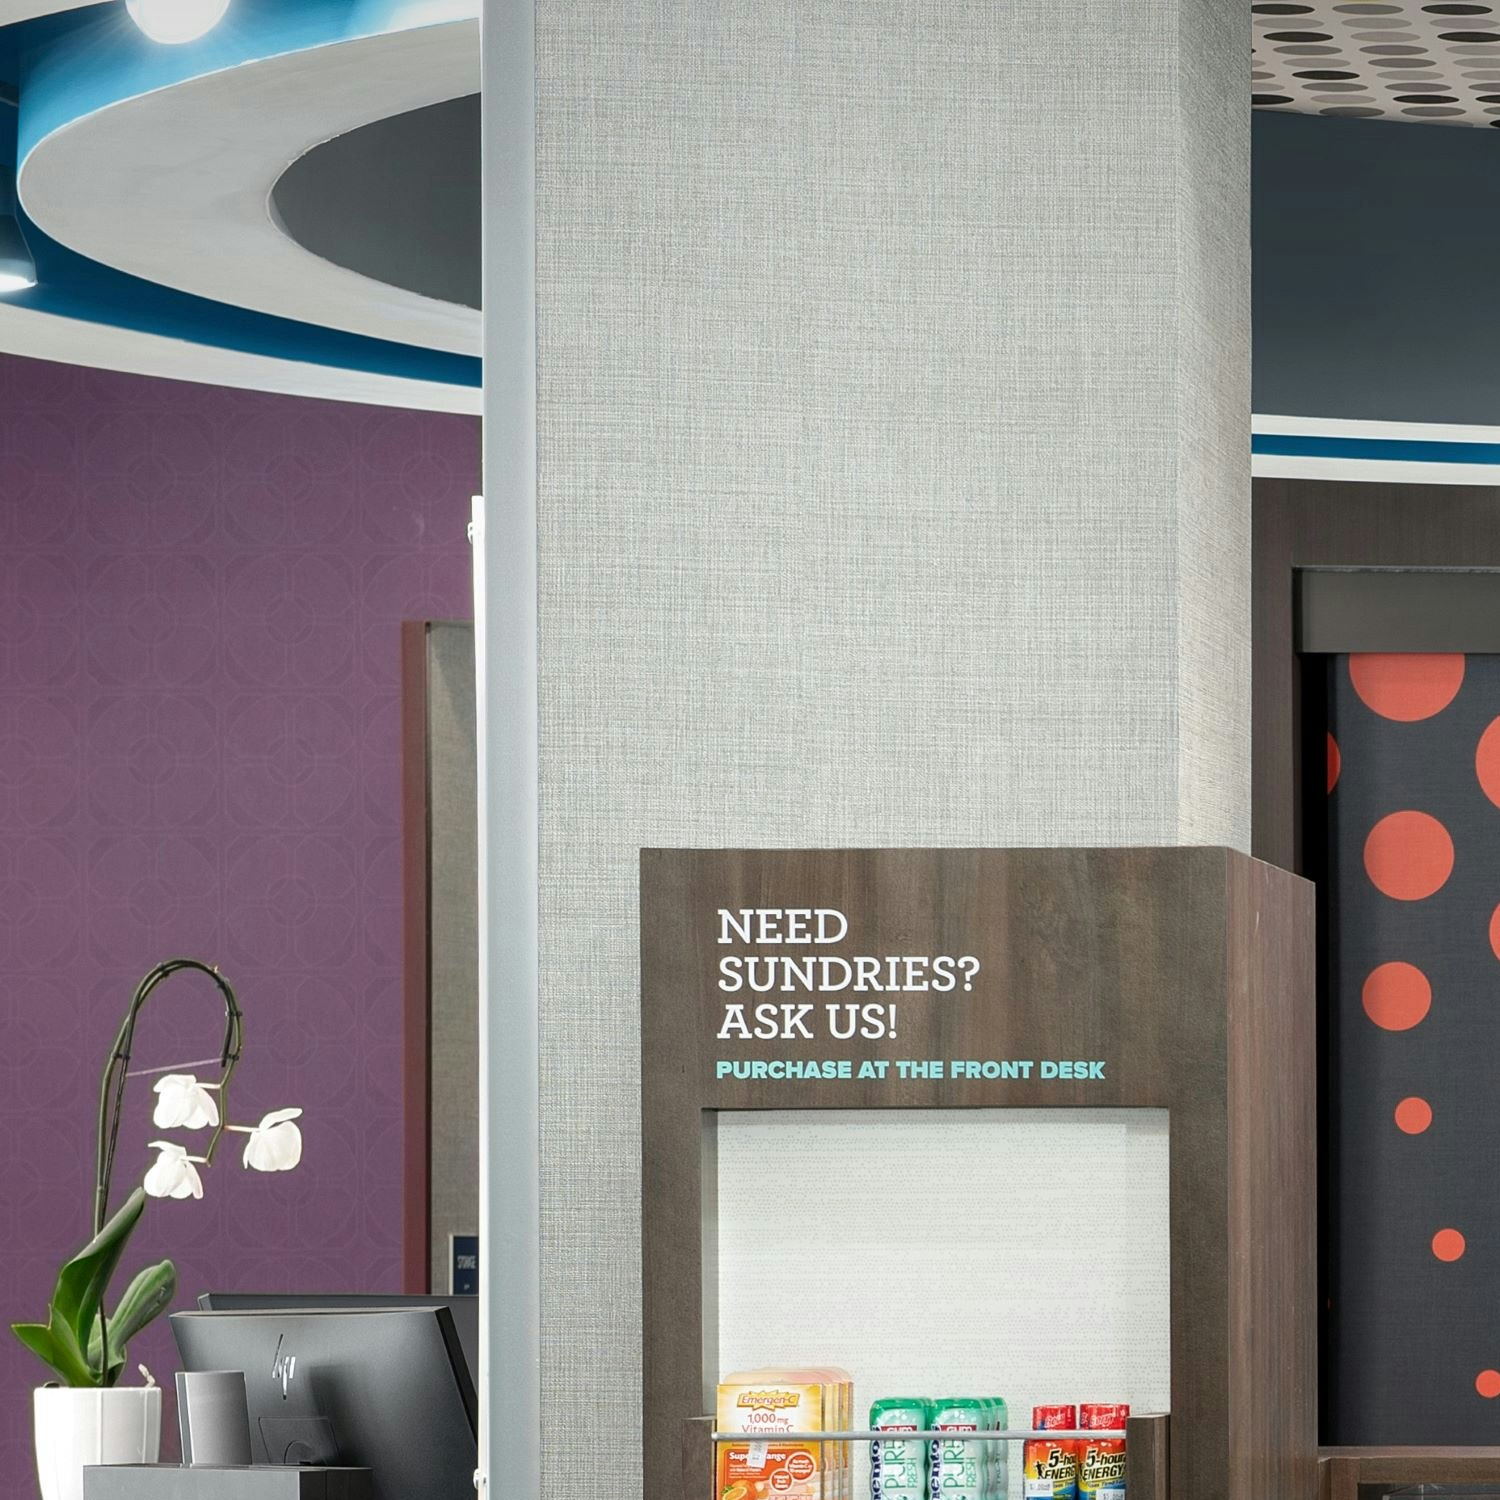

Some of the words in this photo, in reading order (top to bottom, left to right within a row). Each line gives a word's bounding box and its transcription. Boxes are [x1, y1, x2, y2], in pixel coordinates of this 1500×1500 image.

[717, 908, 848, 944] NEED
[717, 955, 980, 993] SUNDRIES?
[716, 1003, 814, 1039] ASK
[825, 1003, 898, 1040] US!
[716, 1060, 852, 1080] PURCHASE
[857, 1060, 890, 1079] AT
[897, 1060, 943, 1079] THE
[950, 1060, 1034, 1079] FRONT
[1040, 1060, 1106, 1079] DESK
